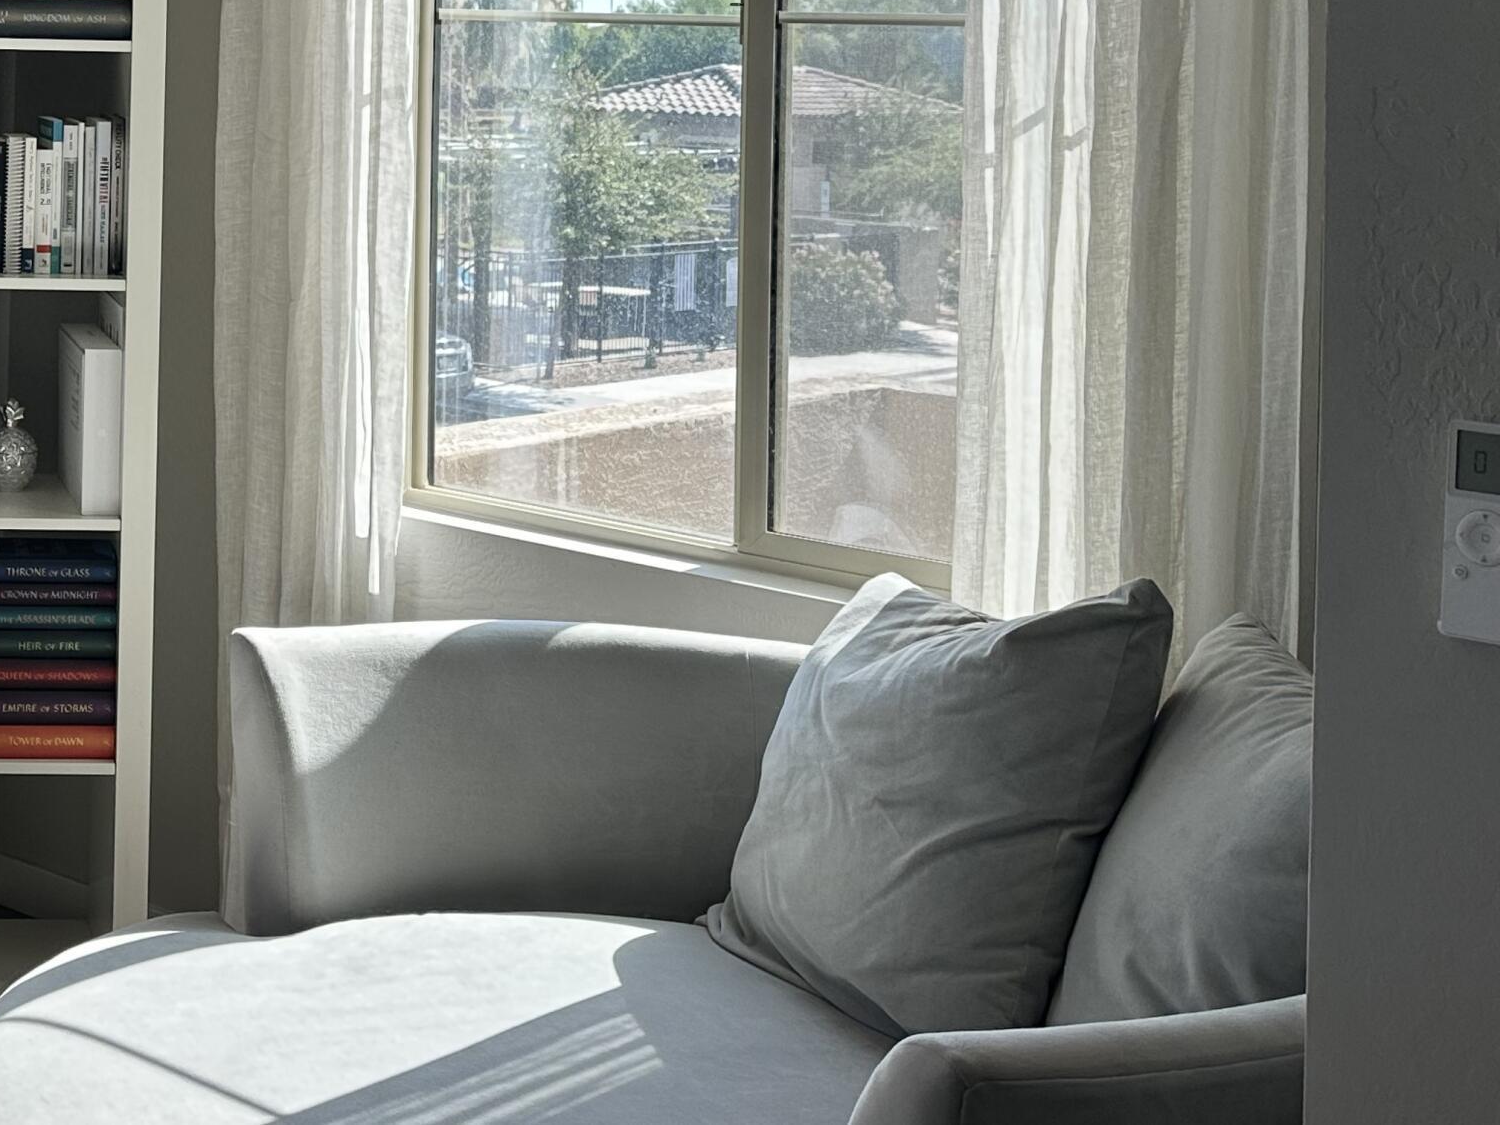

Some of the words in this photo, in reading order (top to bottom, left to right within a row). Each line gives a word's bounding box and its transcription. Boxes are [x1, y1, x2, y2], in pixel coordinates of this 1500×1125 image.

[23, 13, 71, 23] KINGDOM
[88, 15, 107, 24] ASH
[6, 567, 47, 577] THRONE
[60, 568, 91, 578] GLASS
[0, 590, 38, 600] CROWN
[51, 590, 99, 600] MIDNIGHT
[18, 641, 42, 651] HEIR
[58, 642, 81, 651] FIRE
[46, 672, 99, 681] SHADOWS
[2, 703, 37, 713] EMPIRE
[53, 704, 94, 713] STORMS
[9, 736, 41, 746] TOWER
[54, 737, 85, 746] DAWN
